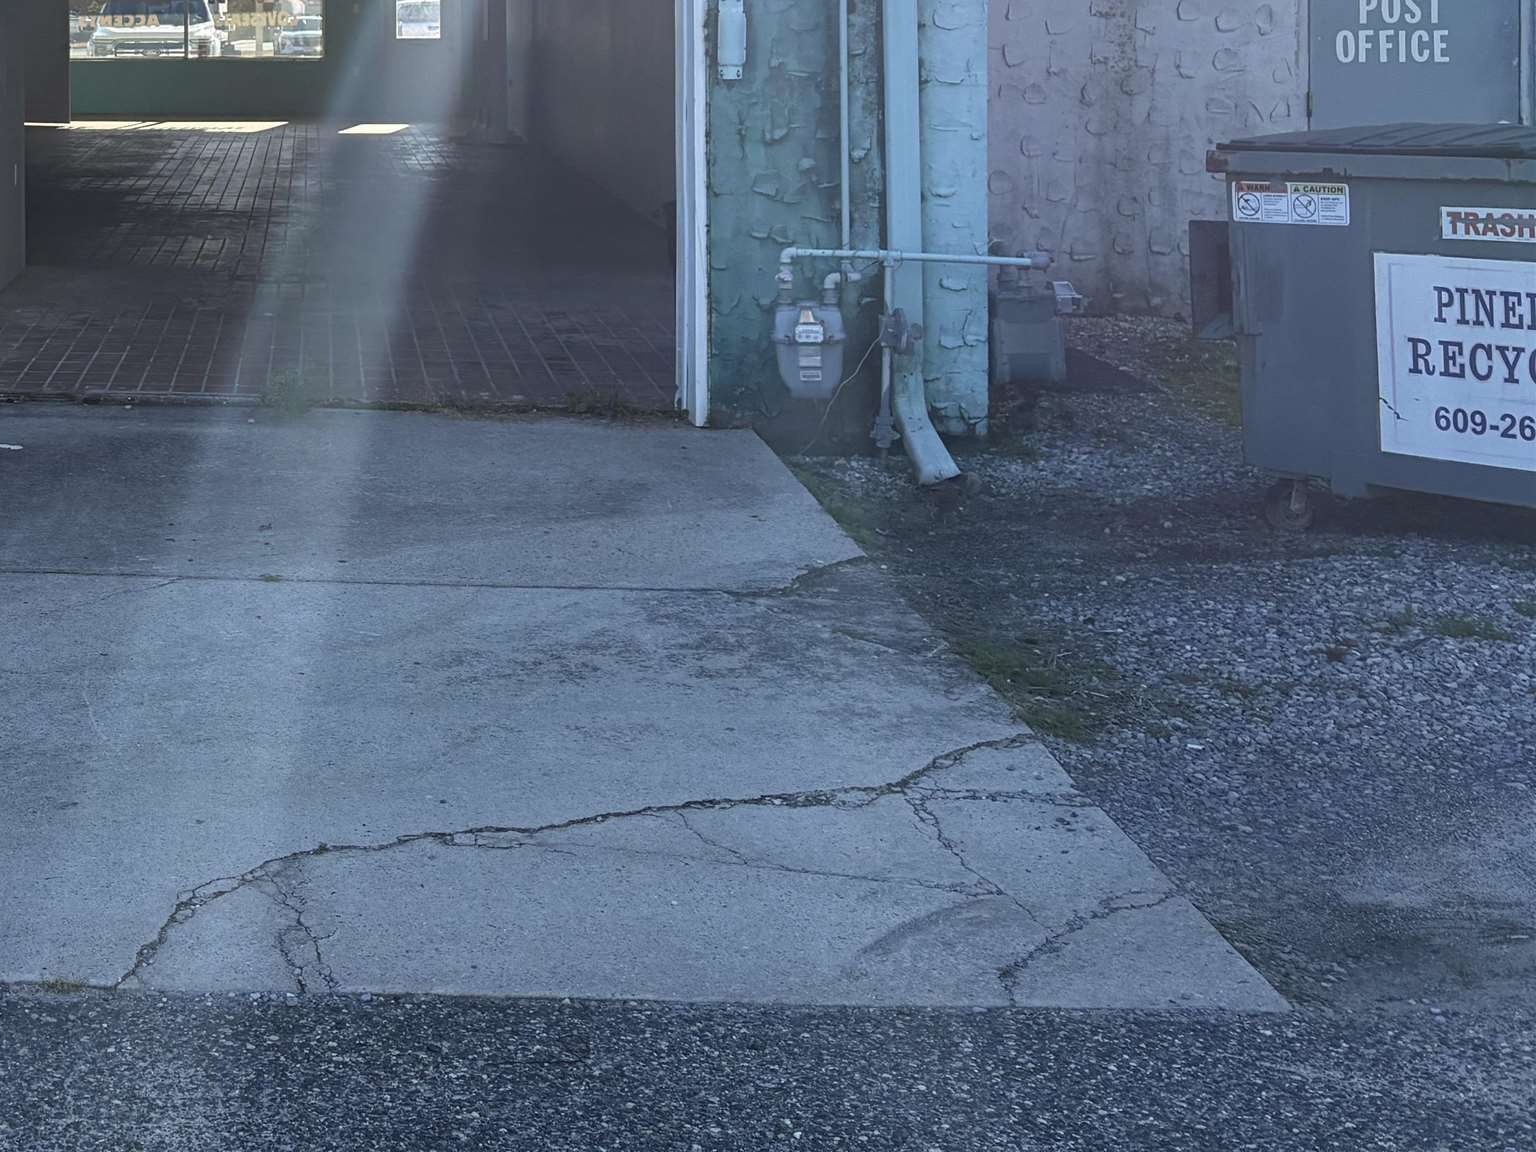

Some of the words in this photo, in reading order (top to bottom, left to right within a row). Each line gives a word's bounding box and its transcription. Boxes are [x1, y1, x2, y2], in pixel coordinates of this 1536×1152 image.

[1335, 29, 1450, 63] OFFICE
[1303, 185, 1344, 194] CAUTION
[1446, 211, 1536, 238] TRASH
[1434, 406, 1536, 441] 609-26
